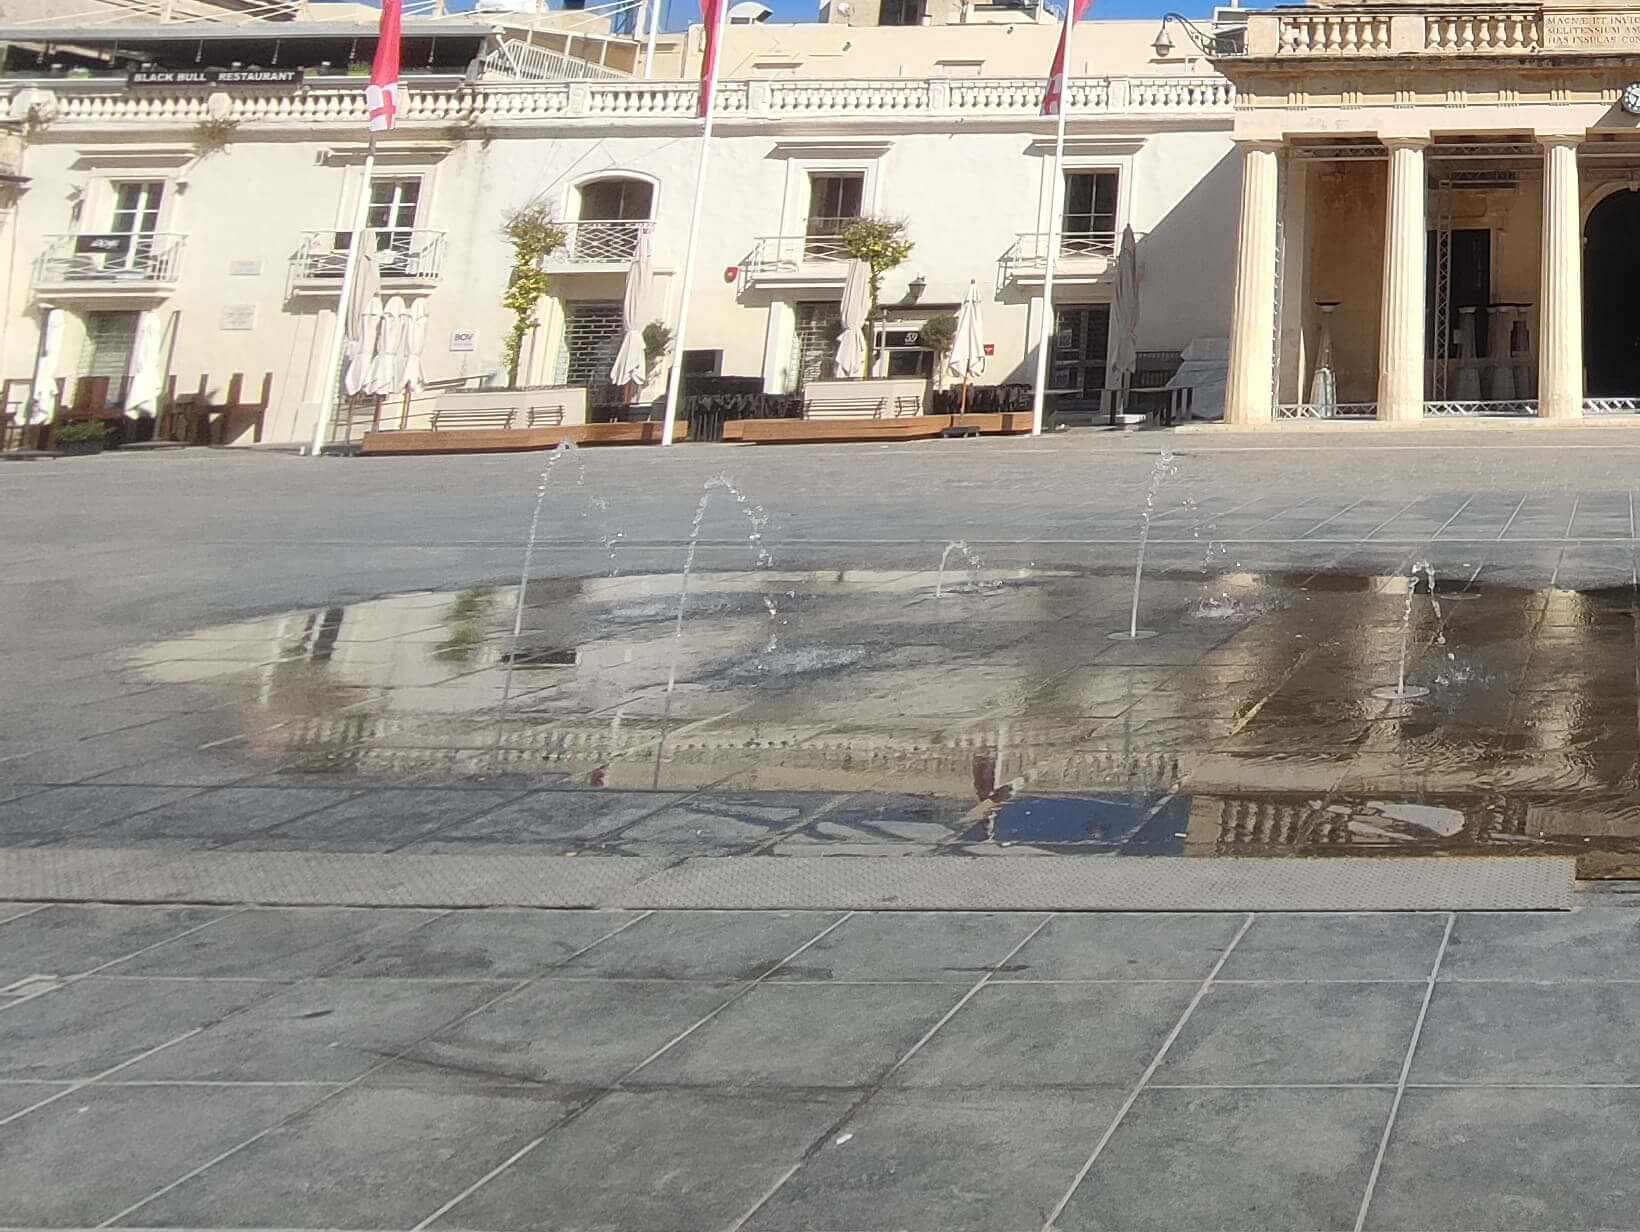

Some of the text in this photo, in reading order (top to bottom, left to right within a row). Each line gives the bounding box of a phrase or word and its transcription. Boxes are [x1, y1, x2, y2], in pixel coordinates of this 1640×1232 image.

[1593, 16, 1606, 25] ET
[133, 71, 295, 82] BLACK BULL RESTAURANT
[455, 333, 473, 341] BOV
